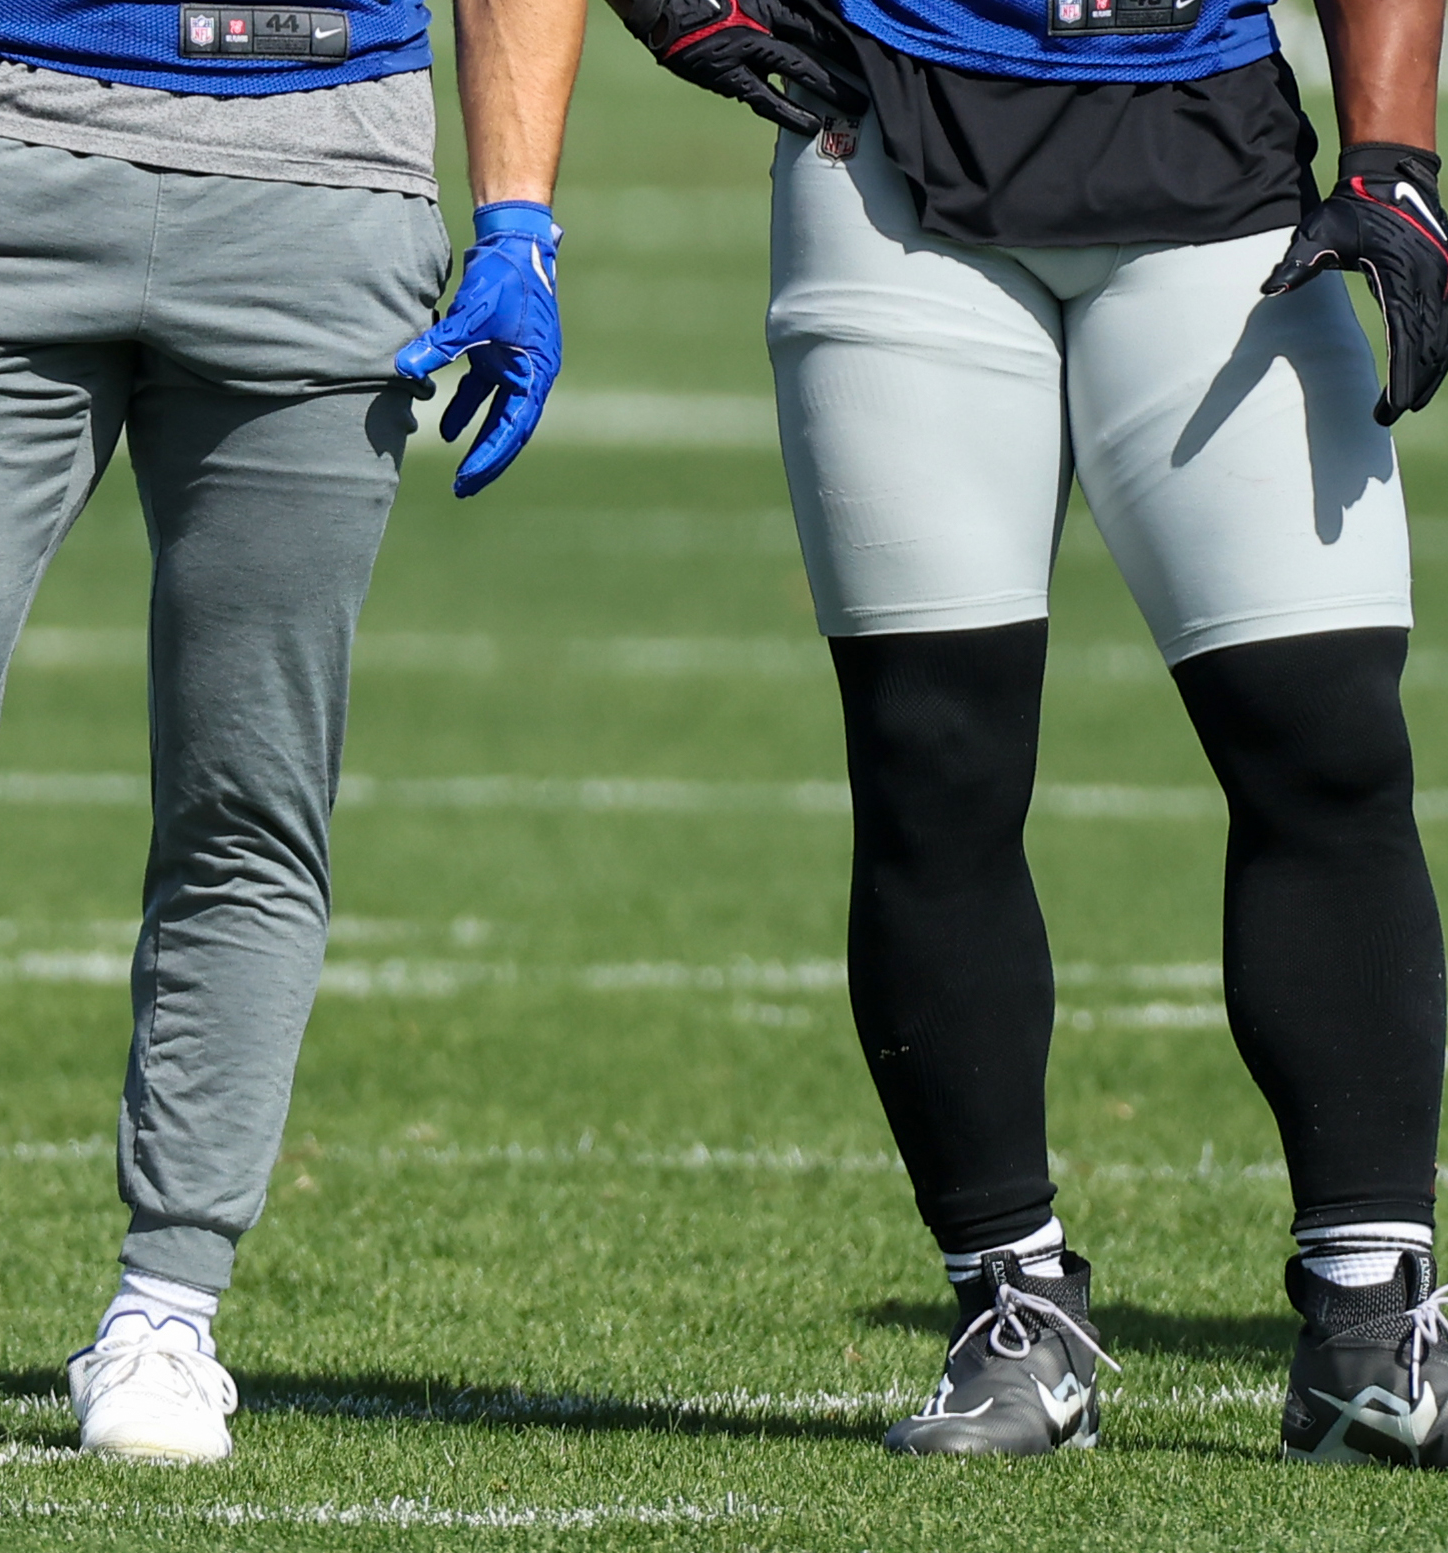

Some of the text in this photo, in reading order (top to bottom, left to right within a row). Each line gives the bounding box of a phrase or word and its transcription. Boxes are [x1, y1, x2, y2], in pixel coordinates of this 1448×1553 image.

[1061, 4, 1081, 19] NFL
[265, 13, 300, 34] 44
[194, 28, 212, 42] NFL
[824, 132, 853, 154] NFL
